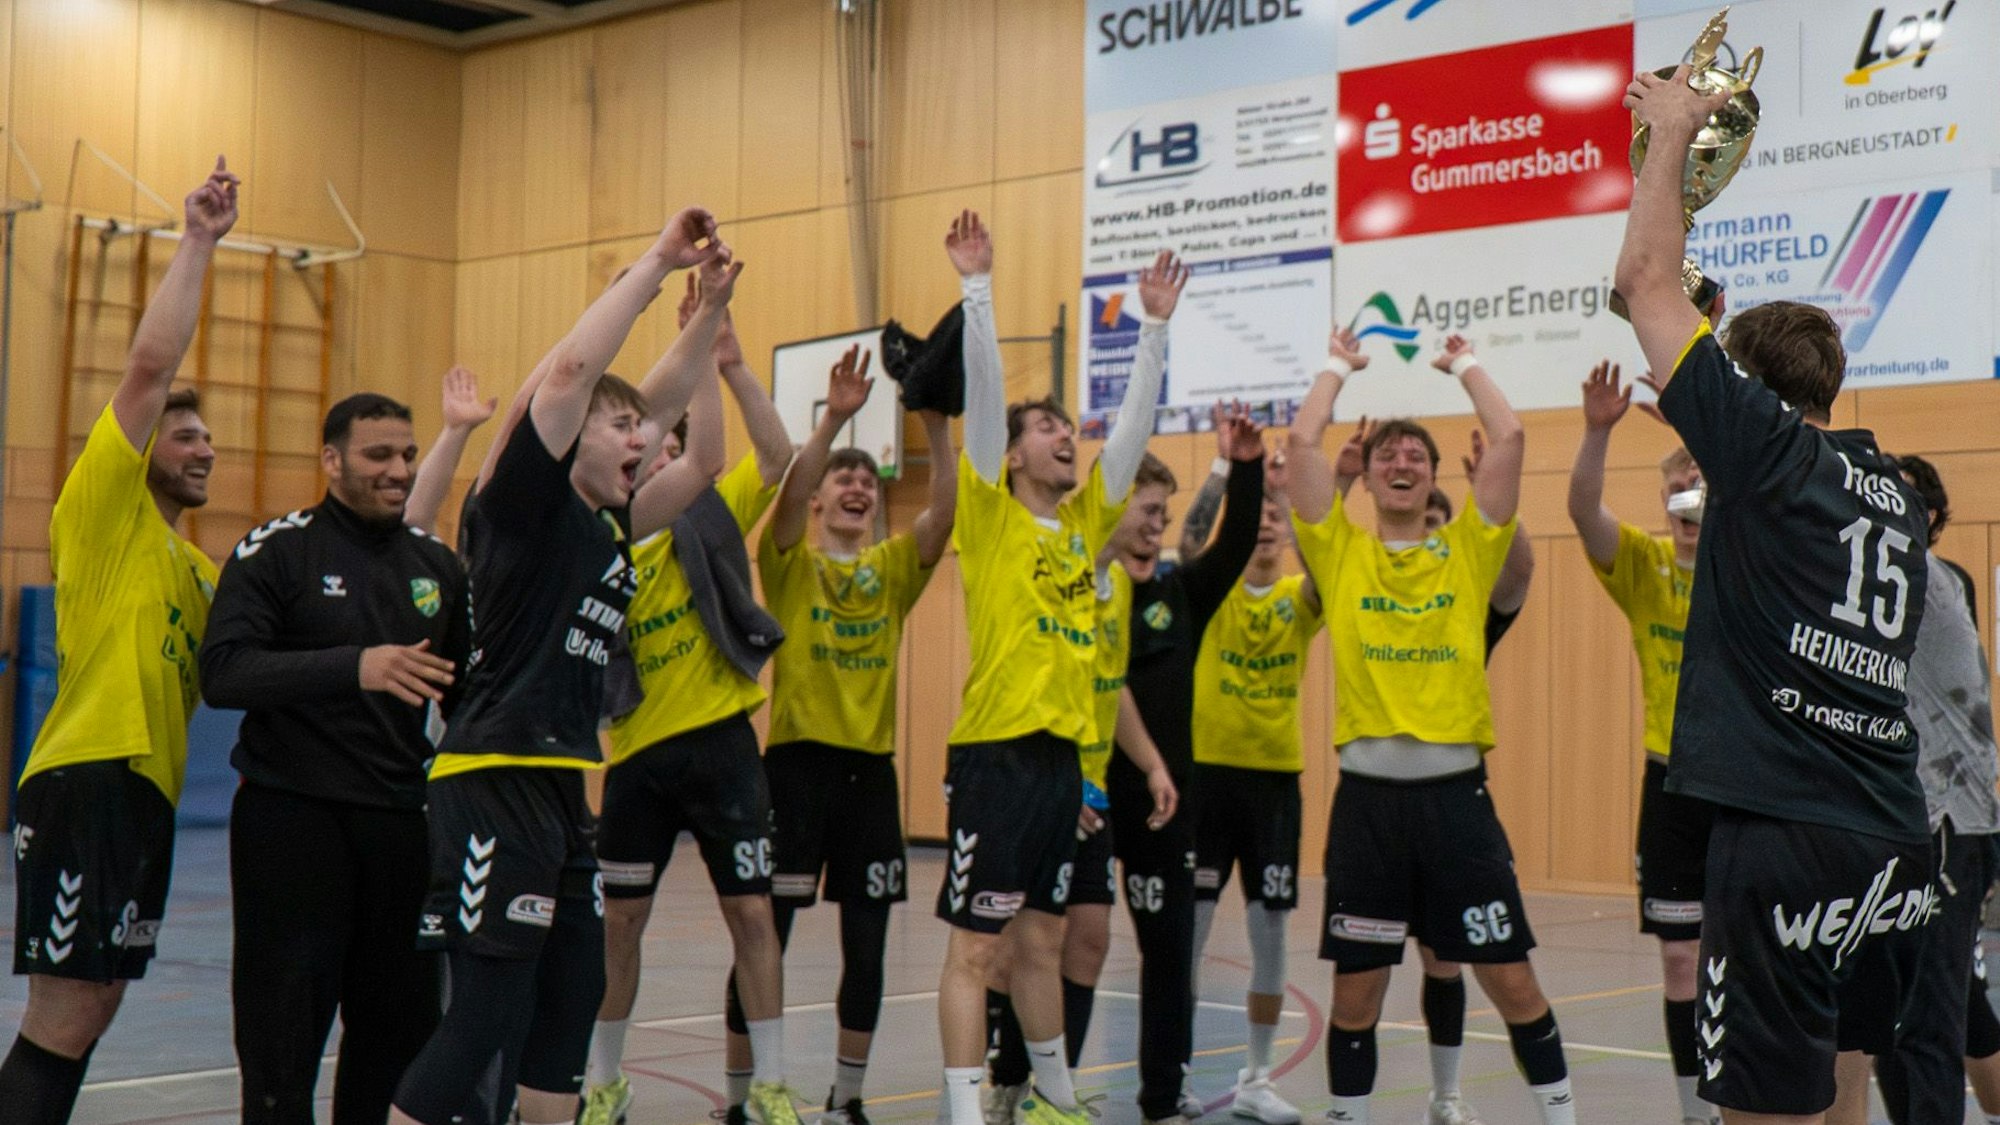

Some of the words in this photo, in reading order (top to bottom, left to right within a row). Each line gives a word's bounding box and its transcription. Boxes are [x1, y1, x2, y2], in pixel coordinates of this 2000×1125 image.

[1845, 95, 1860, 111] in
[1865, 84, 1948, 107] Oberberg
[1131, 122, 1199, 171] HB
[1411, 113, 1543, 159] Sparkasse
[1758, 150, 1777, 169] IN
[1783, 127, 1943, 163] BERGNEUSTADT
[1411, 139, 1601, 193] Gummersbach
[1091, 181, 1328, 227] www.HB-Promotion.de
[1766, 268, 1790, 284] KG
[1411, 276, 1610, 332] AggerEnergi
[1830, 516, 1912, 640] 15
[1463, 900, 1514, 946] SC
